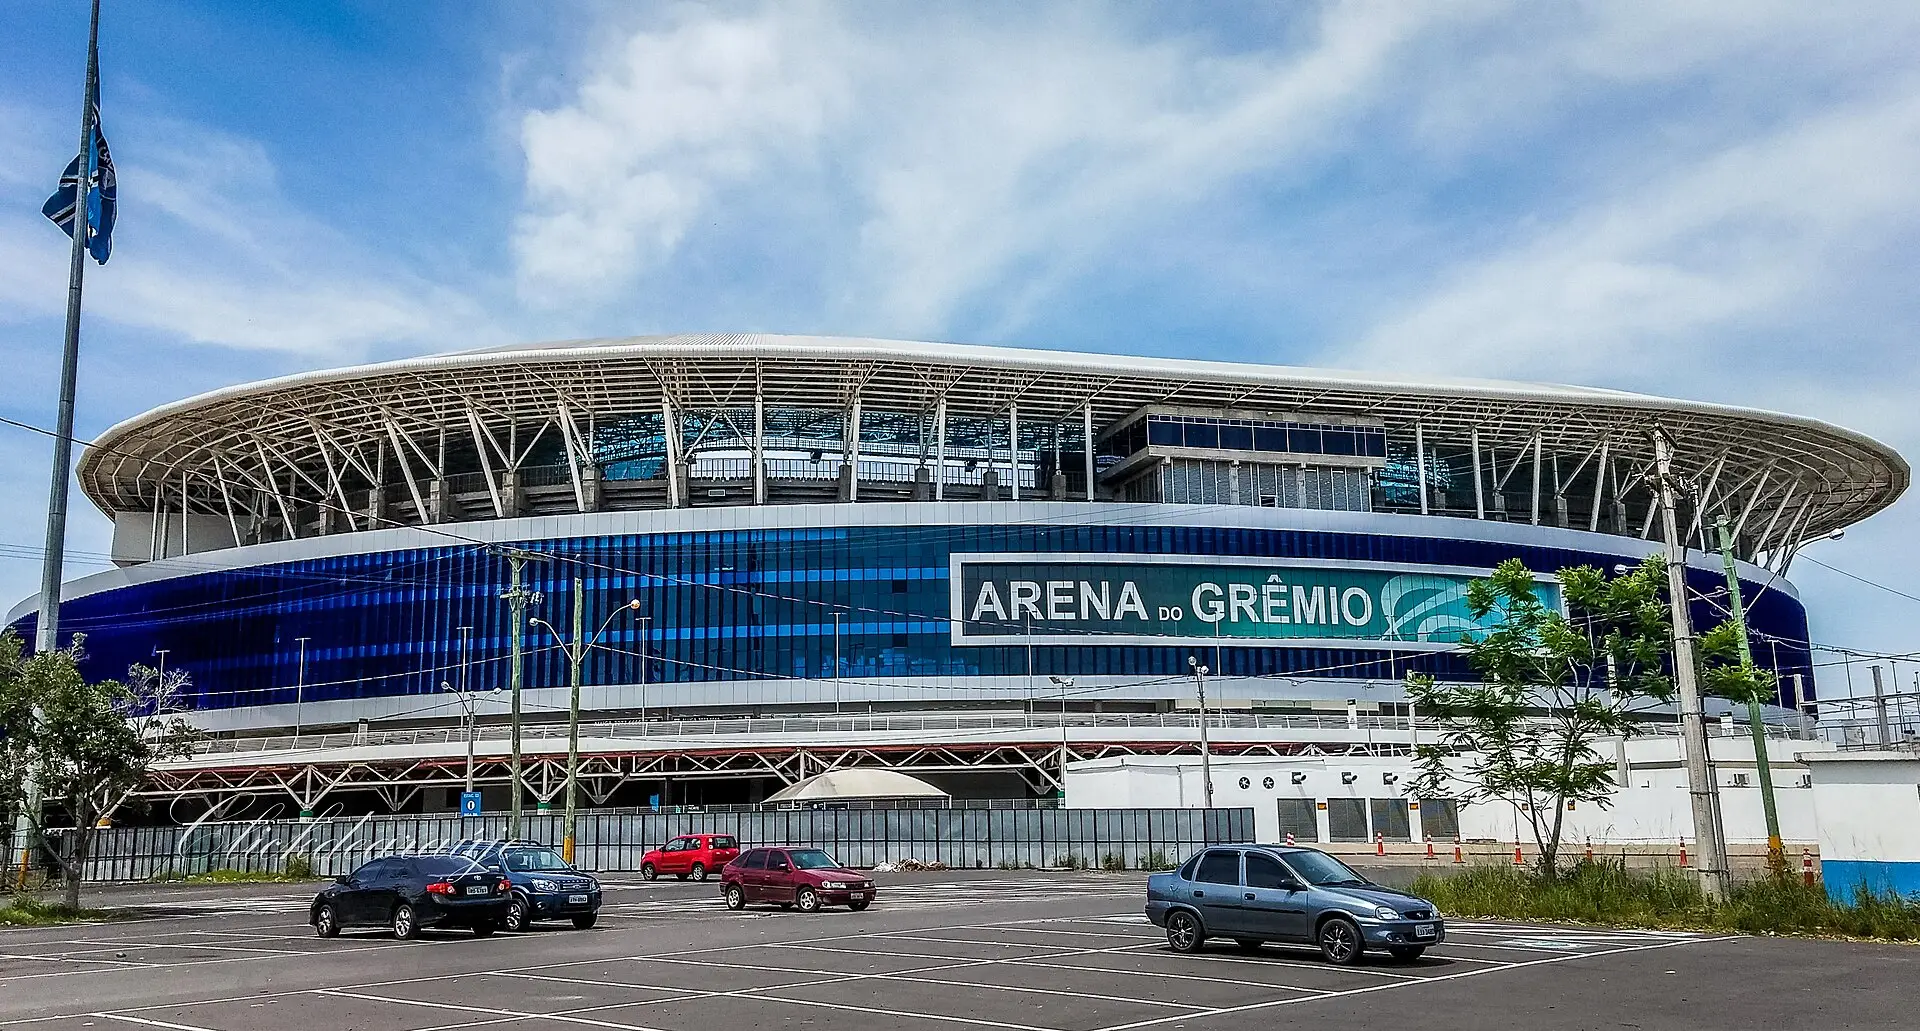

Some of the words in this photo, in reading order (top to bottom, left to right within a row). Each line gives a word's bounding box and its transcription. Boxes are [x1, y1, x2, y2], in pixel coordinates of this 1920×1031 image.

[971, 580, 1149, 621] ARENA
[1158, 606, 1183, 621] DO
[1191, 574, 1373, 626] GRÊMIO
